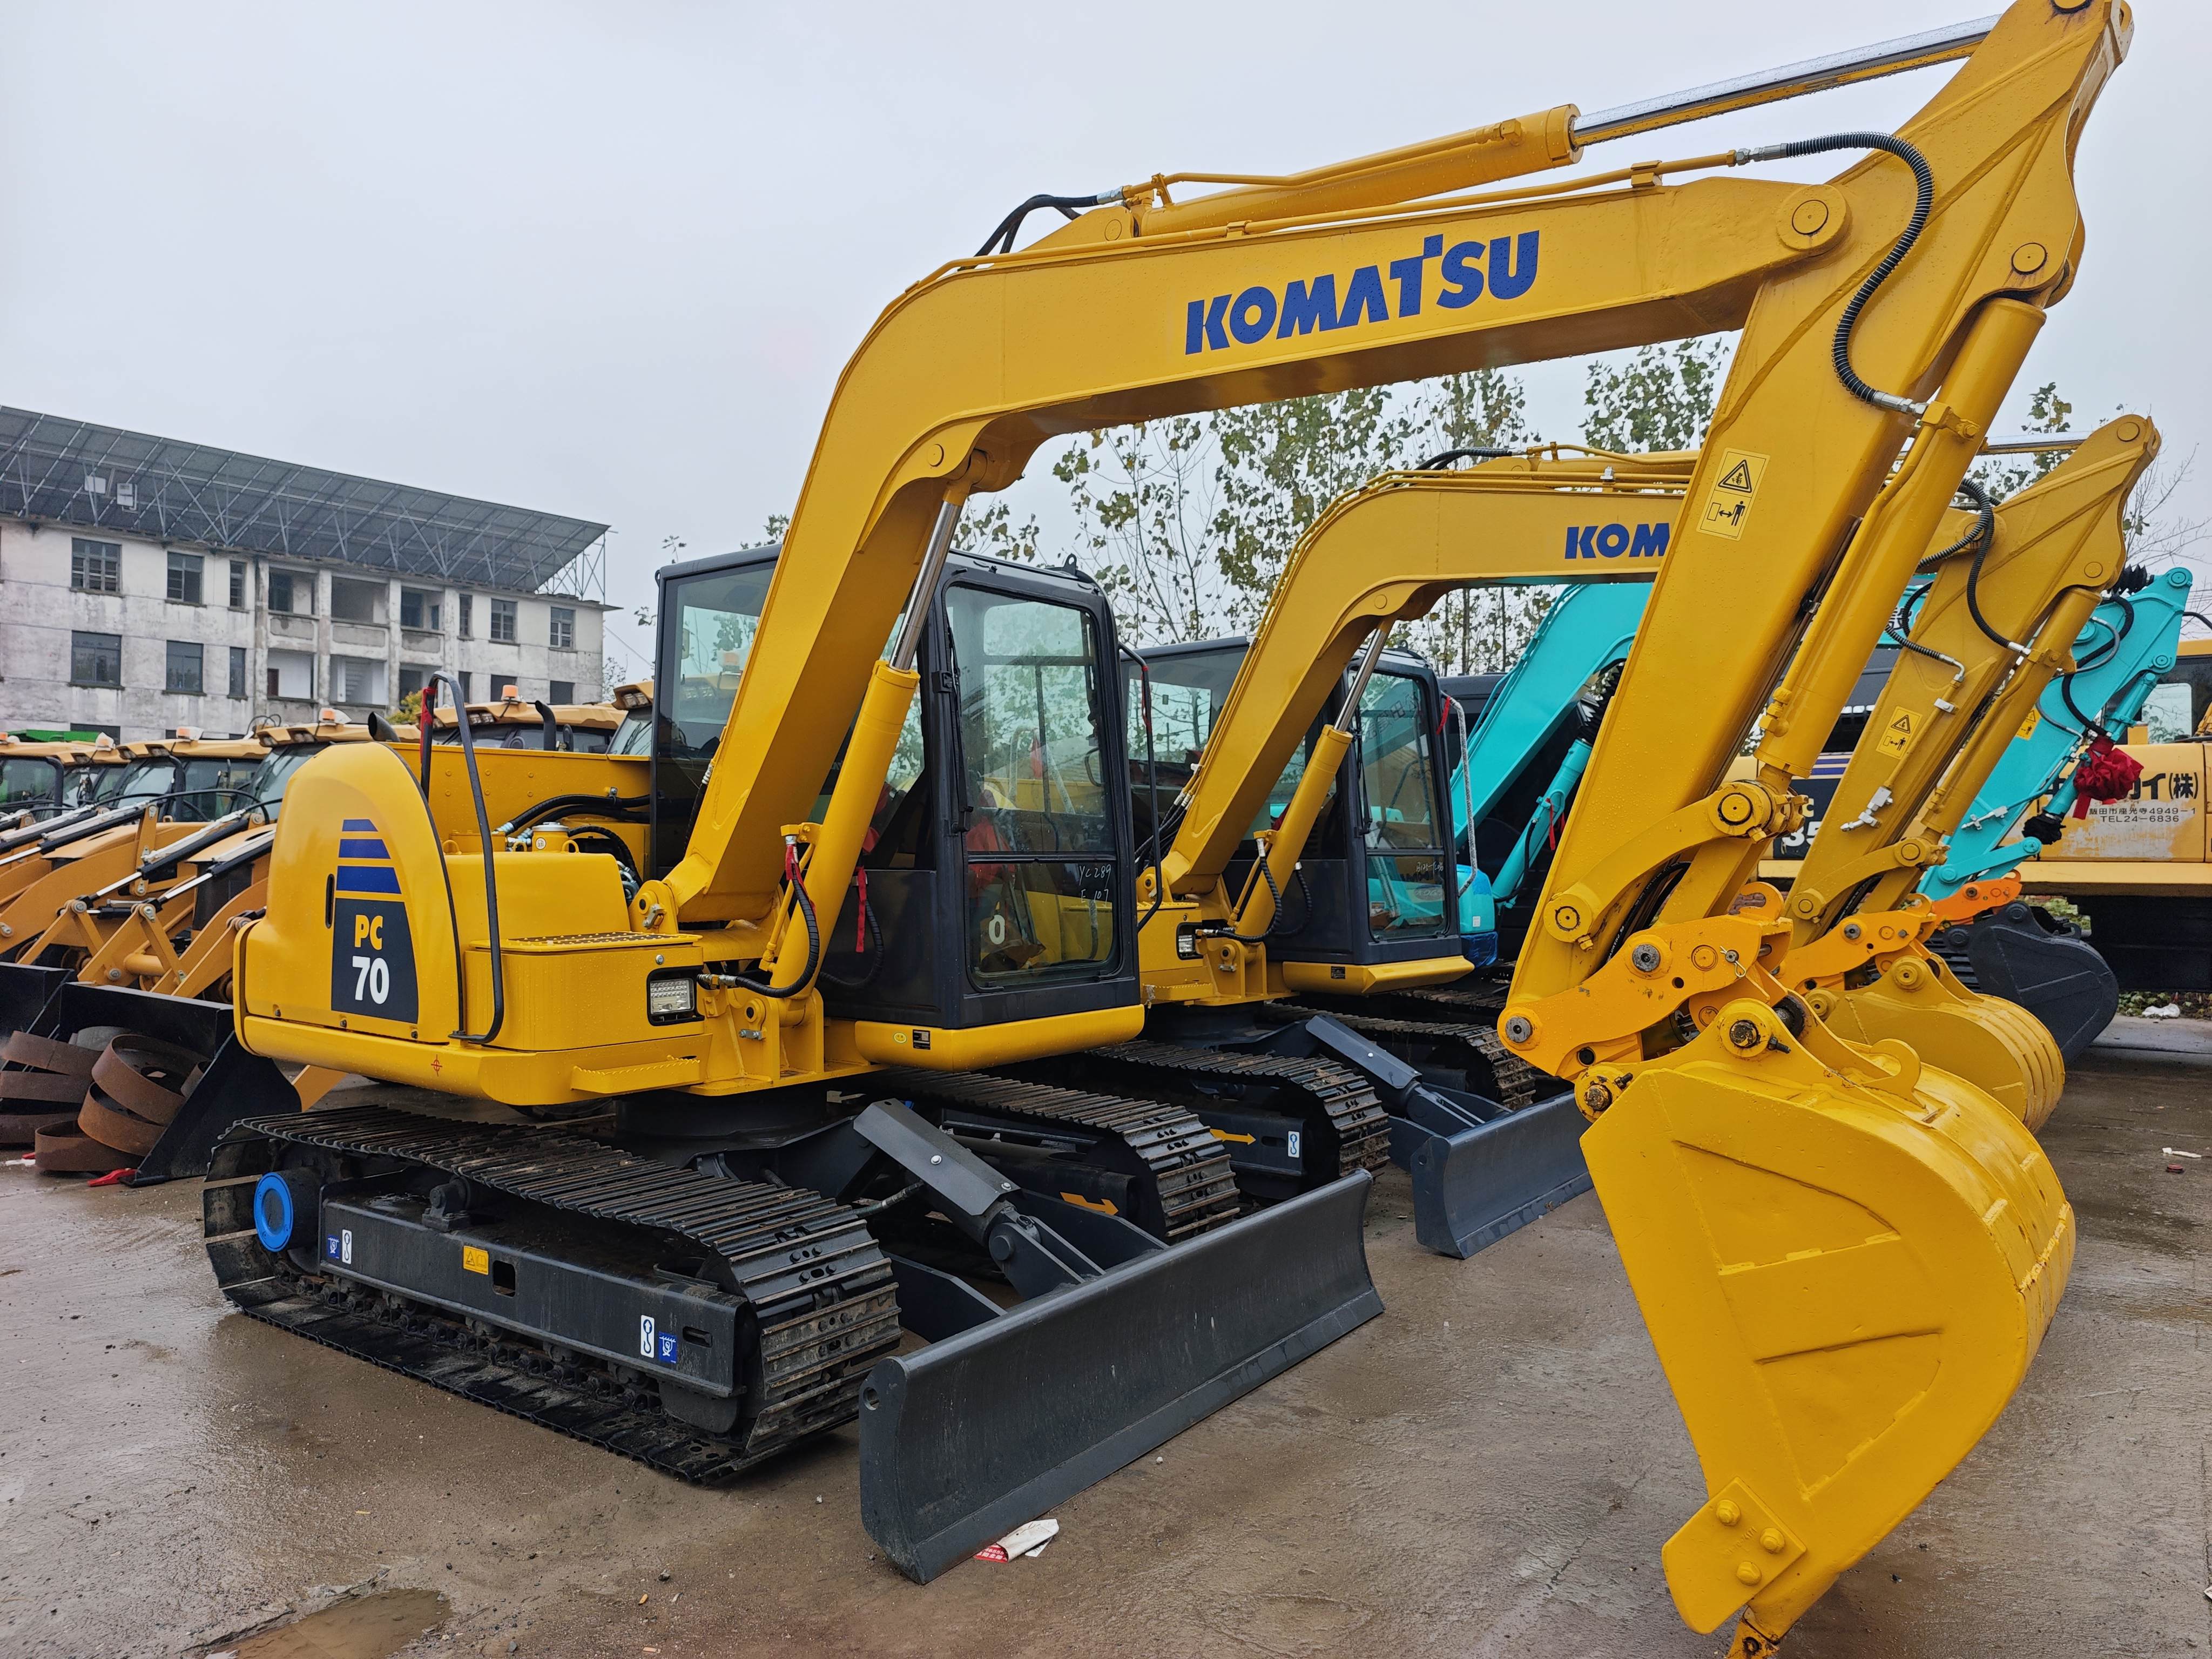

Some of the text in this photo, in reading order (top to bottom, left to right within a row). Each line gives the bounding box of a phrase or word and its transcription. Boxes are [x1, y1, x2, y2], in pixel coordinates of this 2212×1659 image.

[1185, 230, 1540, 355] KOMATSU
[355, 914, 383, 950] PC
[352, 955, 389, 1004] 70
